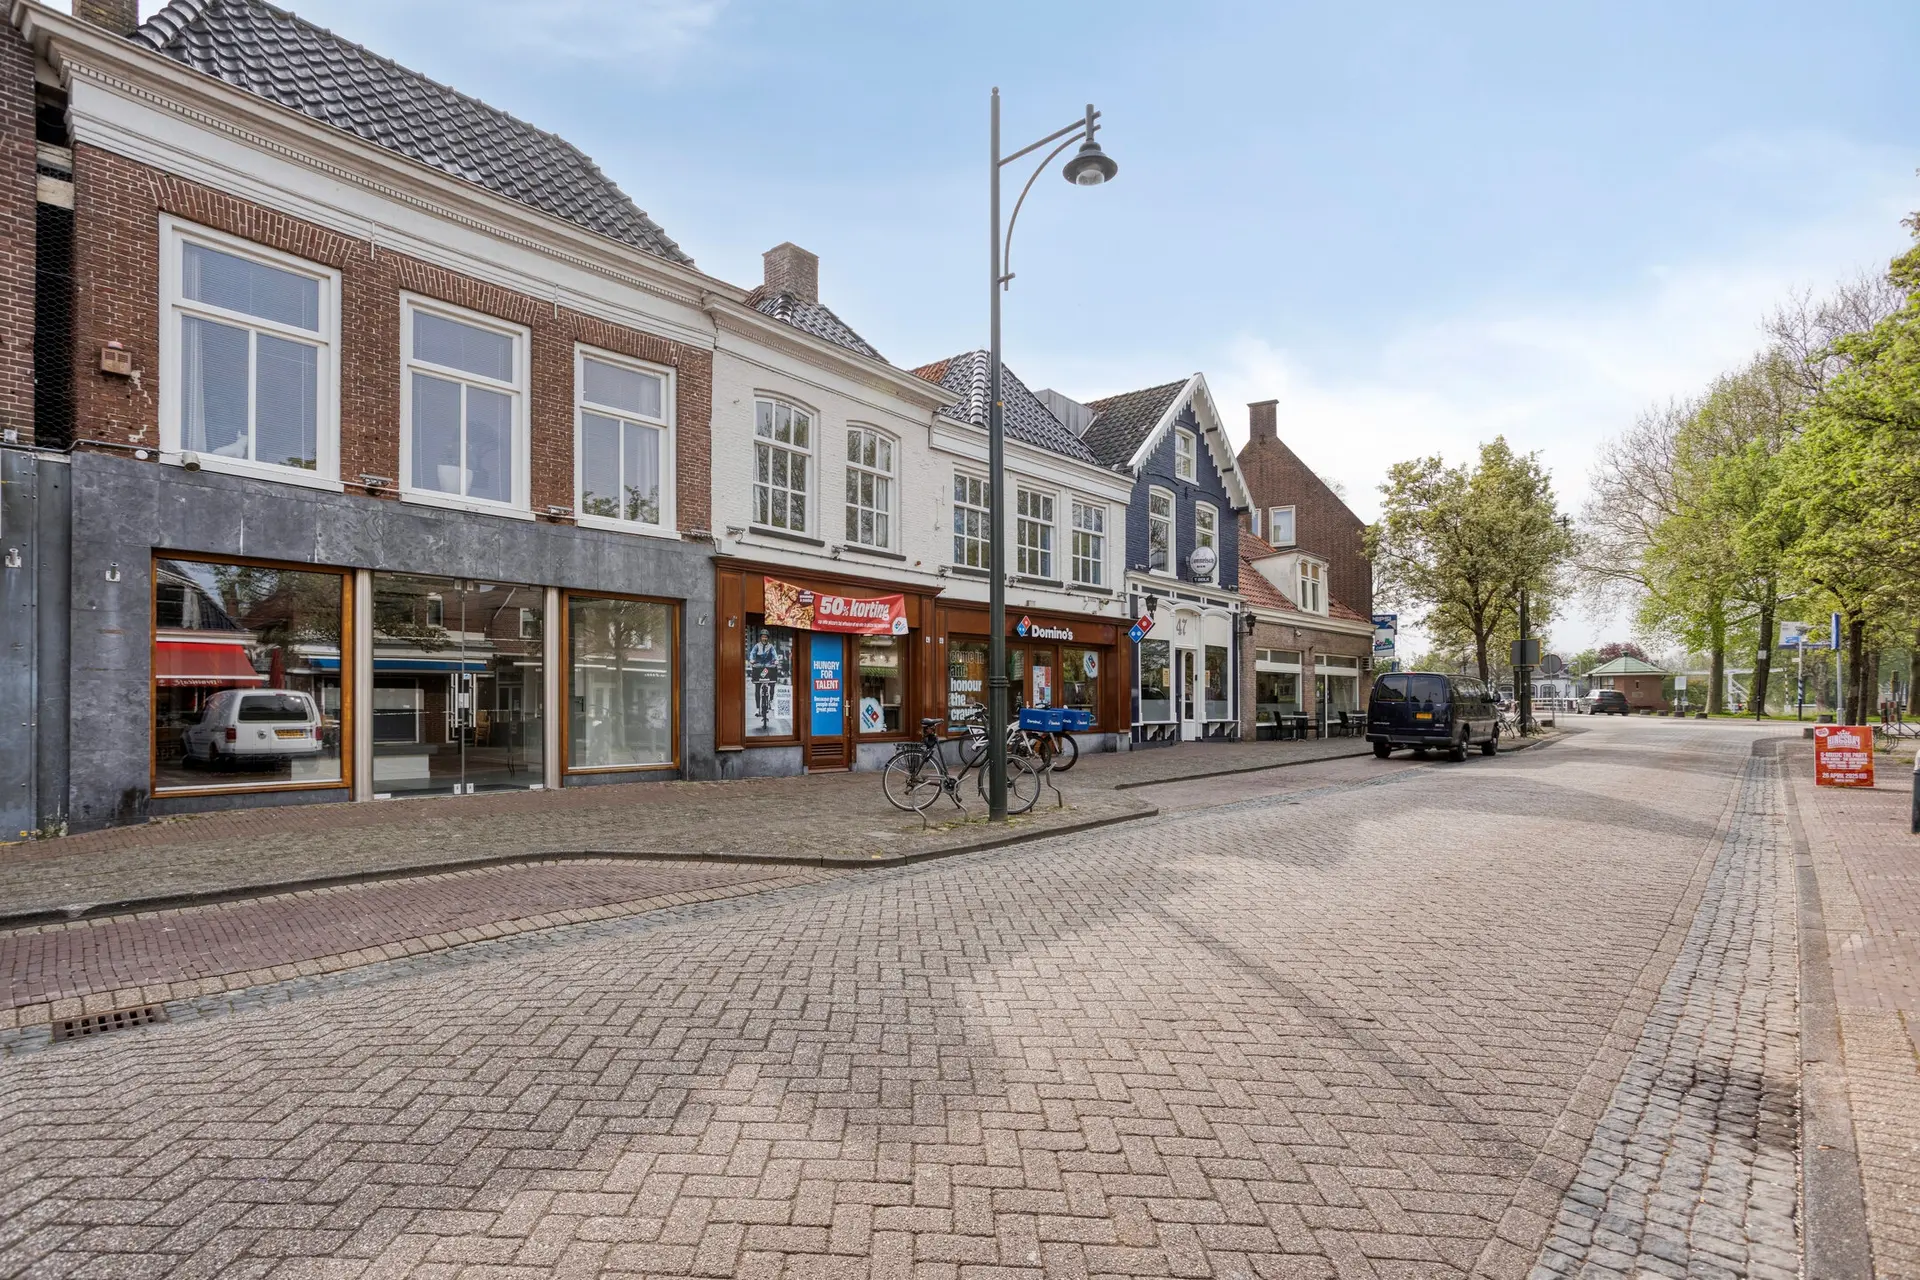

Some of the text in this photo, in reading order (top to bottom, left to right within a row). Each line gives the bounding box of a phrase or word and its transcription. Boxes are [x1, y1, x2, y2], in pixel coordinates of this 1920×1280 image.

[820, 596, 890, 620] 50% korting
[1032, 625, 1073, 640] Domino's
[1176, 618, 1188, 636] 47
[814, 660, 840, 670] HUNGRY
[950, 664, 968, 678] and
[820, 670, 833, 679] FOR
[815, 680, 838, 690] TALENT
[950, 678, 982, 691] honour
[950, 692, 966, 706] the
